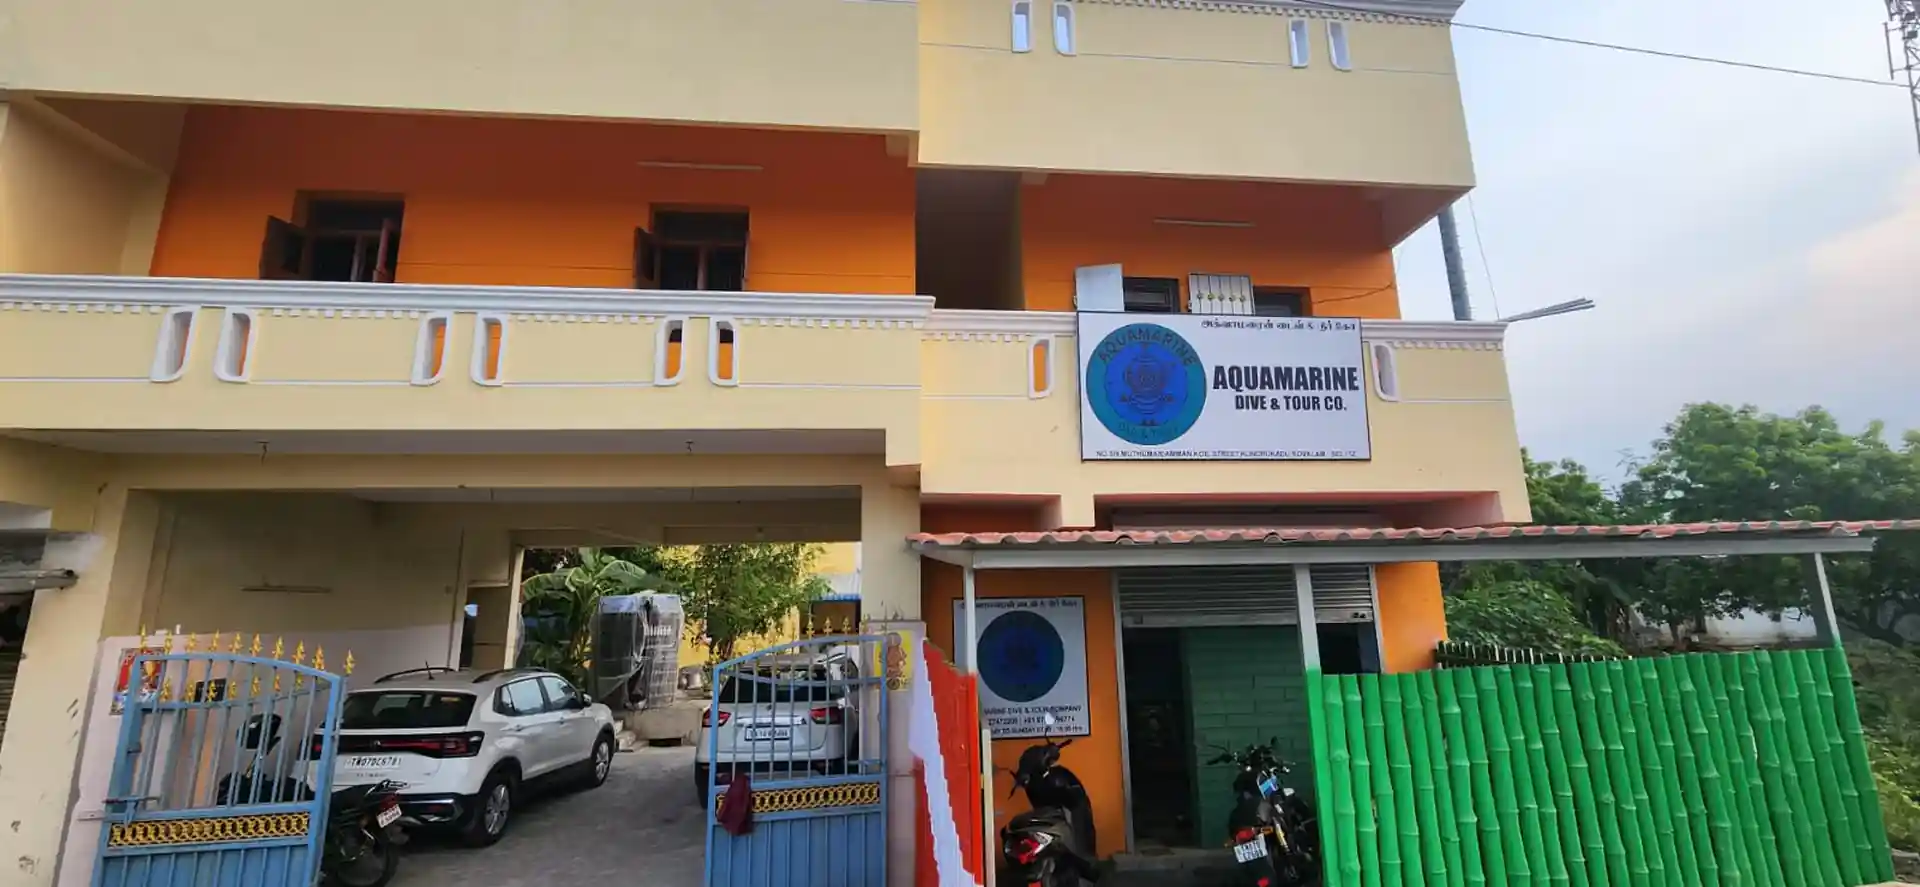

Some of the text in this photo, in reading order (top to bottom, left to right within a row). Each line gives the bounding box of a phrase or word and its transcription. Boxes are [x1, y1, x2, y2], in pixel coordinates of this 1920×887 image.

[1099, 327, 1197, 367] AQUAMARINE
[1212, 365, 1359, 392] AQUAMARINE
[1235, 395, 1347, 411] DIVE & TOUR CO.
